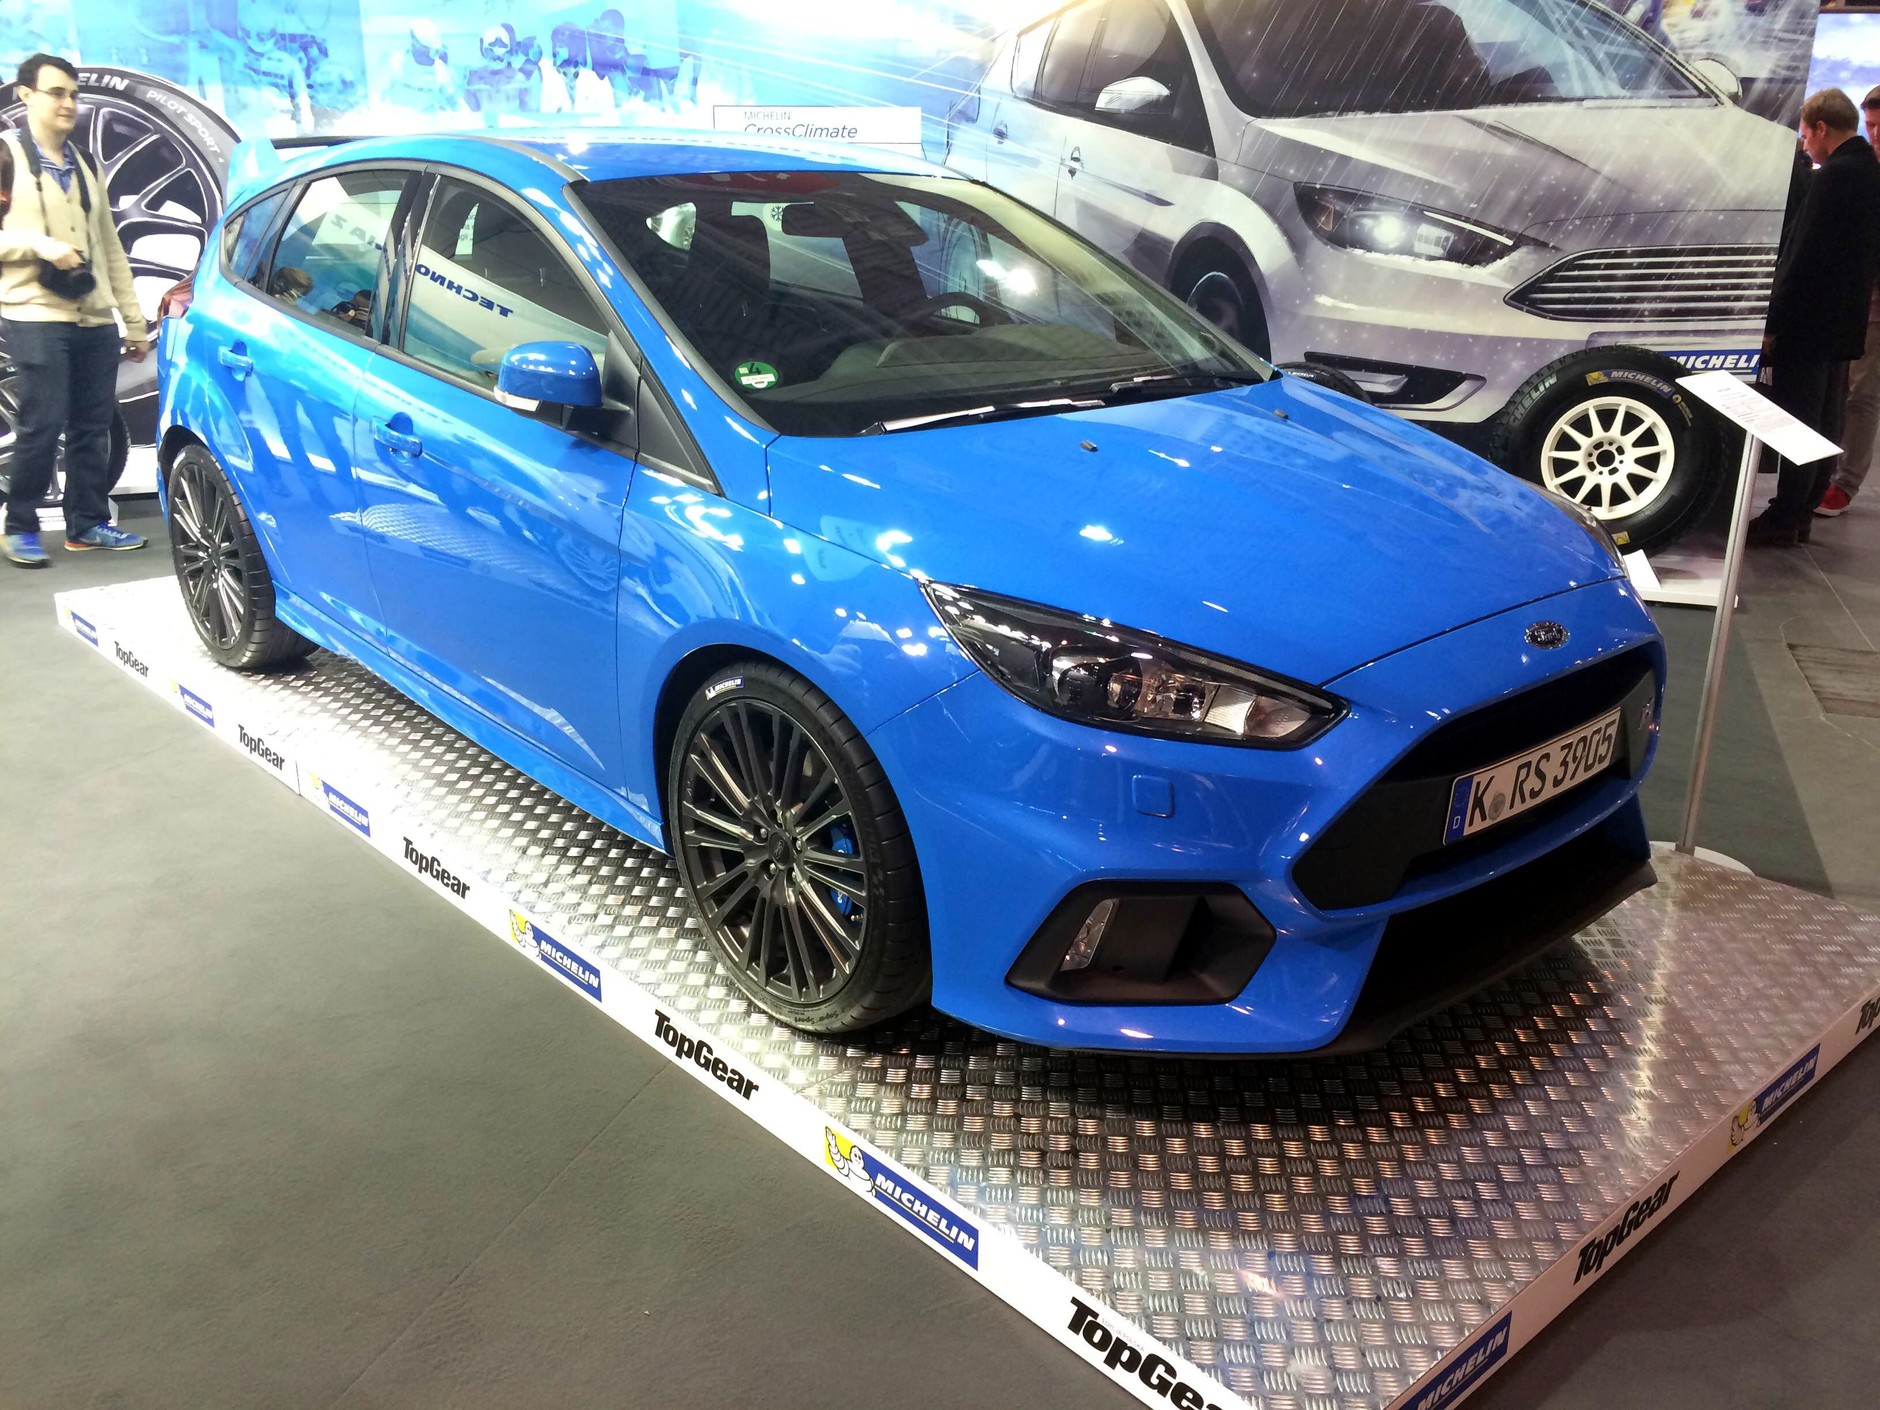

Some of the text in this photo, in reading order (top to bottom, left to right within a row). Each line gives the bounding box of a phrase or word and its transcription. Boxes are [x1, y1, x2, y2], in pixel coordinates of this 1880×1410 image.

[77, 72, 130, 91] ELIN
[146, 90, 186, 115] PILOT
[183, 112, 220, 153] SPORT
[744, 111, 791, 121] MICHELIN
[1610, 371, 1672, 393] MICHELIN
[1669, 354, 1761, 369] MICHELI
[1509, 371, 1558, 426] CHELIN
[114, 640, 149, 678] TopGear
[238, 724, 285, 771] TopGear
[1468, 718, 1617, 828] K RS 3905
[1452, 815, 1461, 830] D
[403, 836, 470, 900] TopGear
[539, 939, 600, 989] MICHELIN
[654, 1008, 759, 1101] TopGear
[1761, 1054, 1818, 1111] MICHELIN
[874, 1172, 976, 1251] MICHELIN
[1573, 1170, 1681, 1286] TopGear
[1067, 1296, 1224, 1410] TopGe
[1416, 1326, 1508, 1410] MICHELIN
